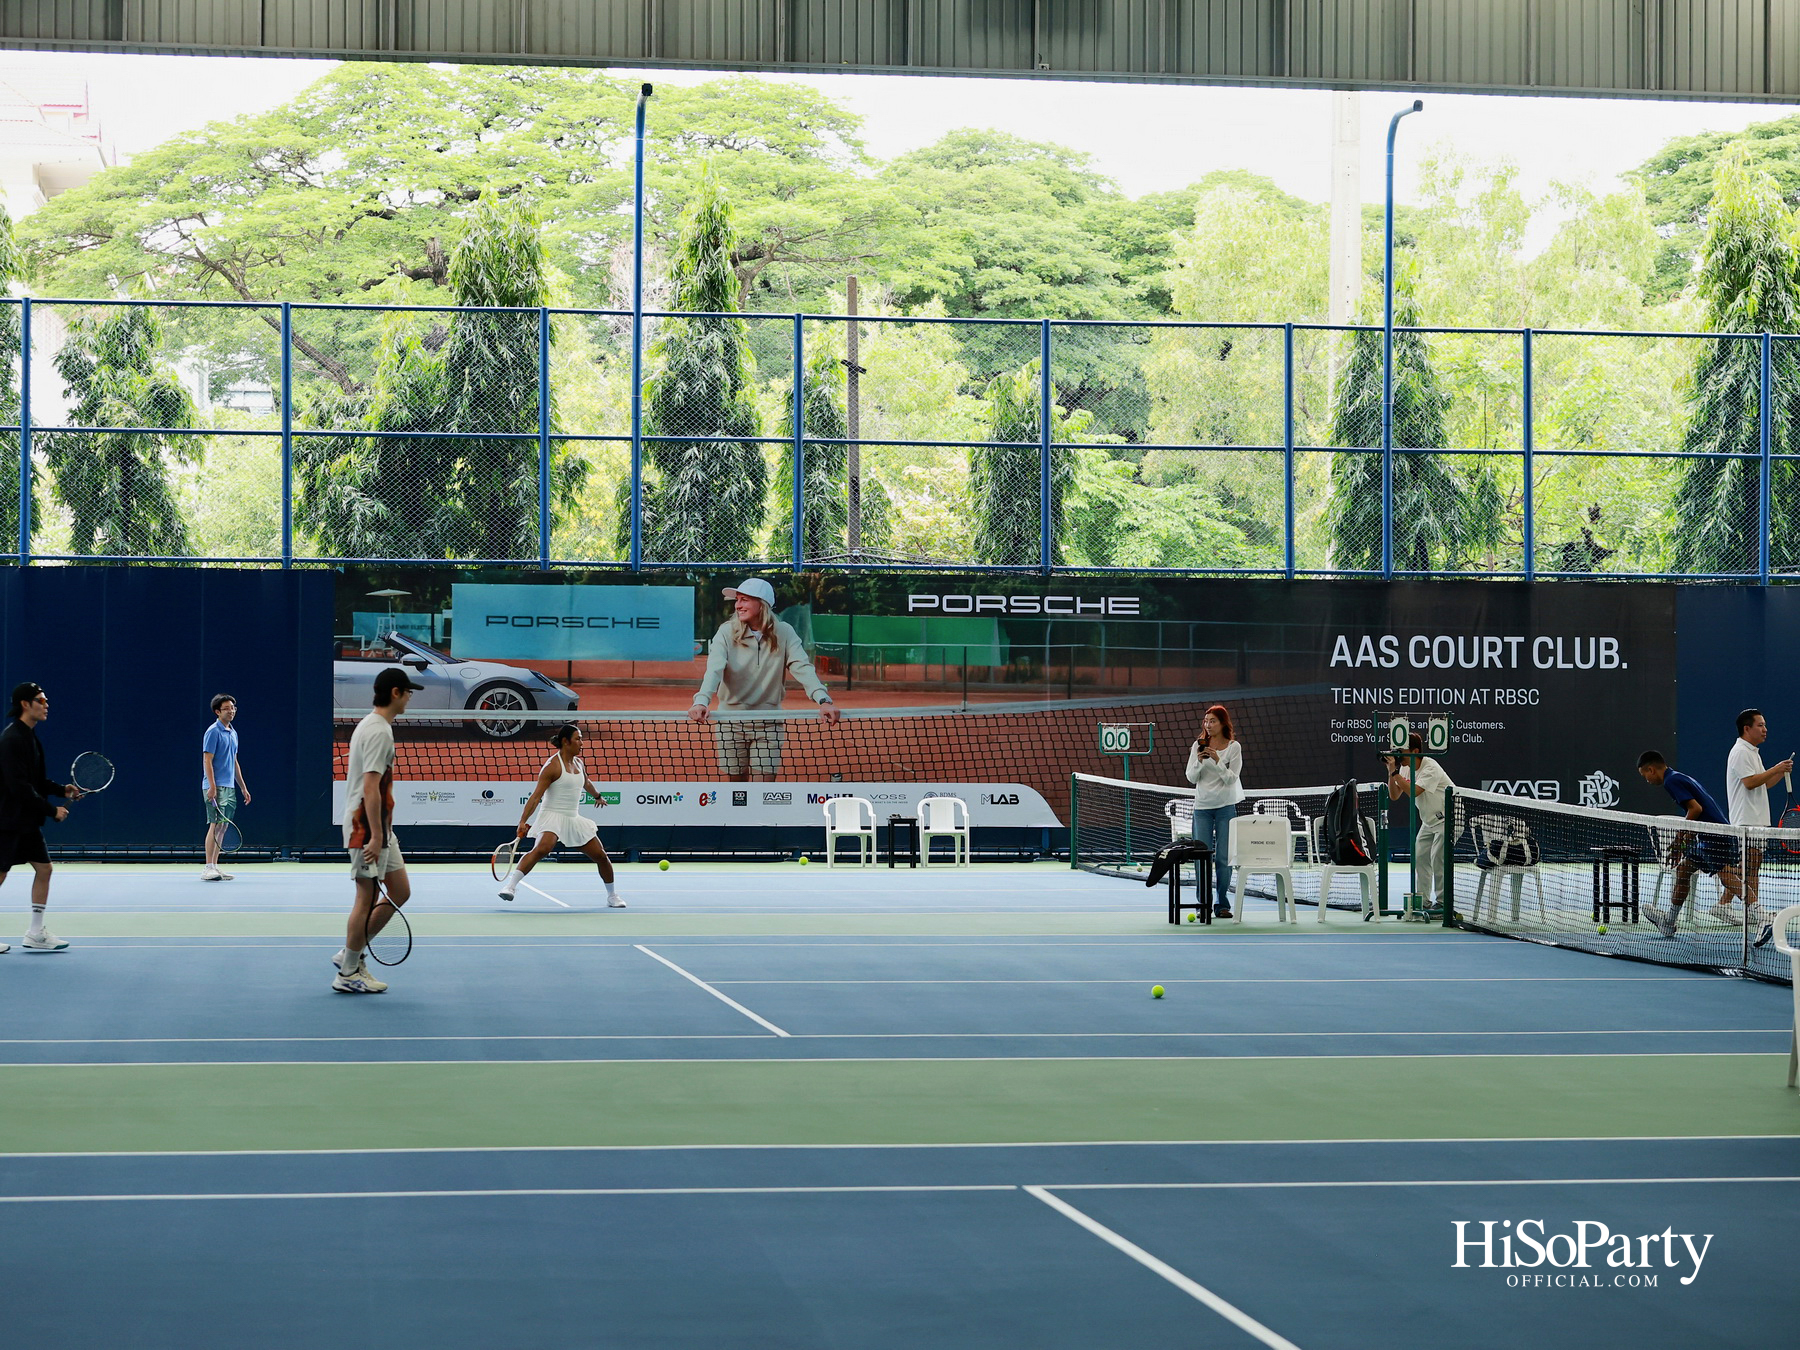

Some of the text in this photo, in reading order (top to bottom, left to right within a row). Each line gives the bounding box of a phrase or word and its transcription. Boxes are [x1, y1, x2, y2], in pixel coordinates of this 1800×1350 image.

[907, 594, 1140, 615] PORSCHE
[485, 615, 660, 629] PORSCHE
[1329, 635, 1628, 670] AAS COURT CLUB.
[1330, 687, 1540, 706] TENNIS EDITION AT RBSC
[1330, 719, 1345, 730] For
[1347, 719, 1373, 730] RBSC
[1417, 720, 1429, 730] an
[1456, 719, 1506, 731] Customers.
[1330, 733, 1364, 744] Choose
[1462, 733, 1485, 744] Club.
[763, 792, 792, 801] AAS
[869, 793, 907, 801] VOSS
[1486, 780, 1561, 804] AAS
[636, 794, 672, 805] OSIM
[980, 793, 1020, 805] MLAB
